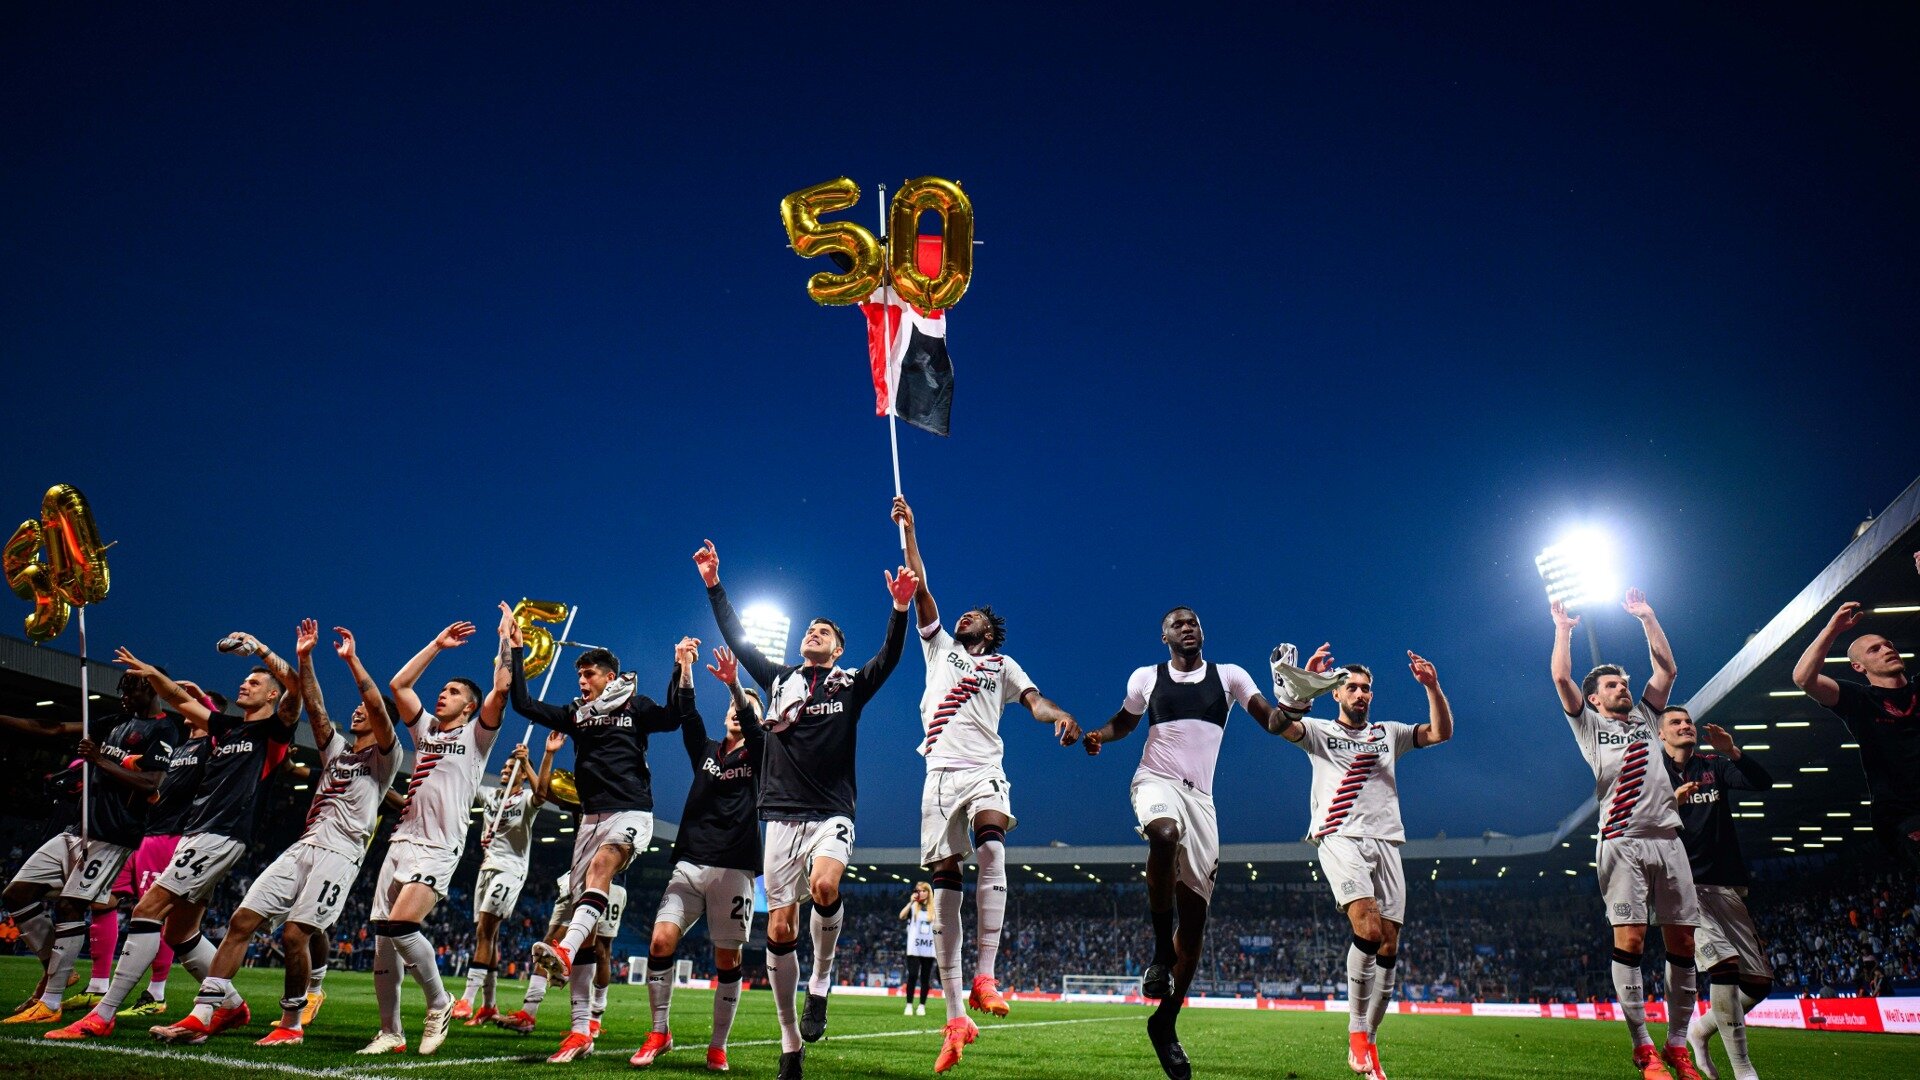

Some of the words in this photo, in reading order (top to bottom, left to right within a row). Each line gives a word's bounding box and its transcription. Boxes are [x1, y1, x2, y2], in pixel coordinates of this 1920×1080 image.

[835, 823, 854, 845] 2
[83, 859, 102, 880] 6
[174, 848, 209, 877] 34
[316, 879, 341, 907] 13
[491, 883, 510, 902] 21
